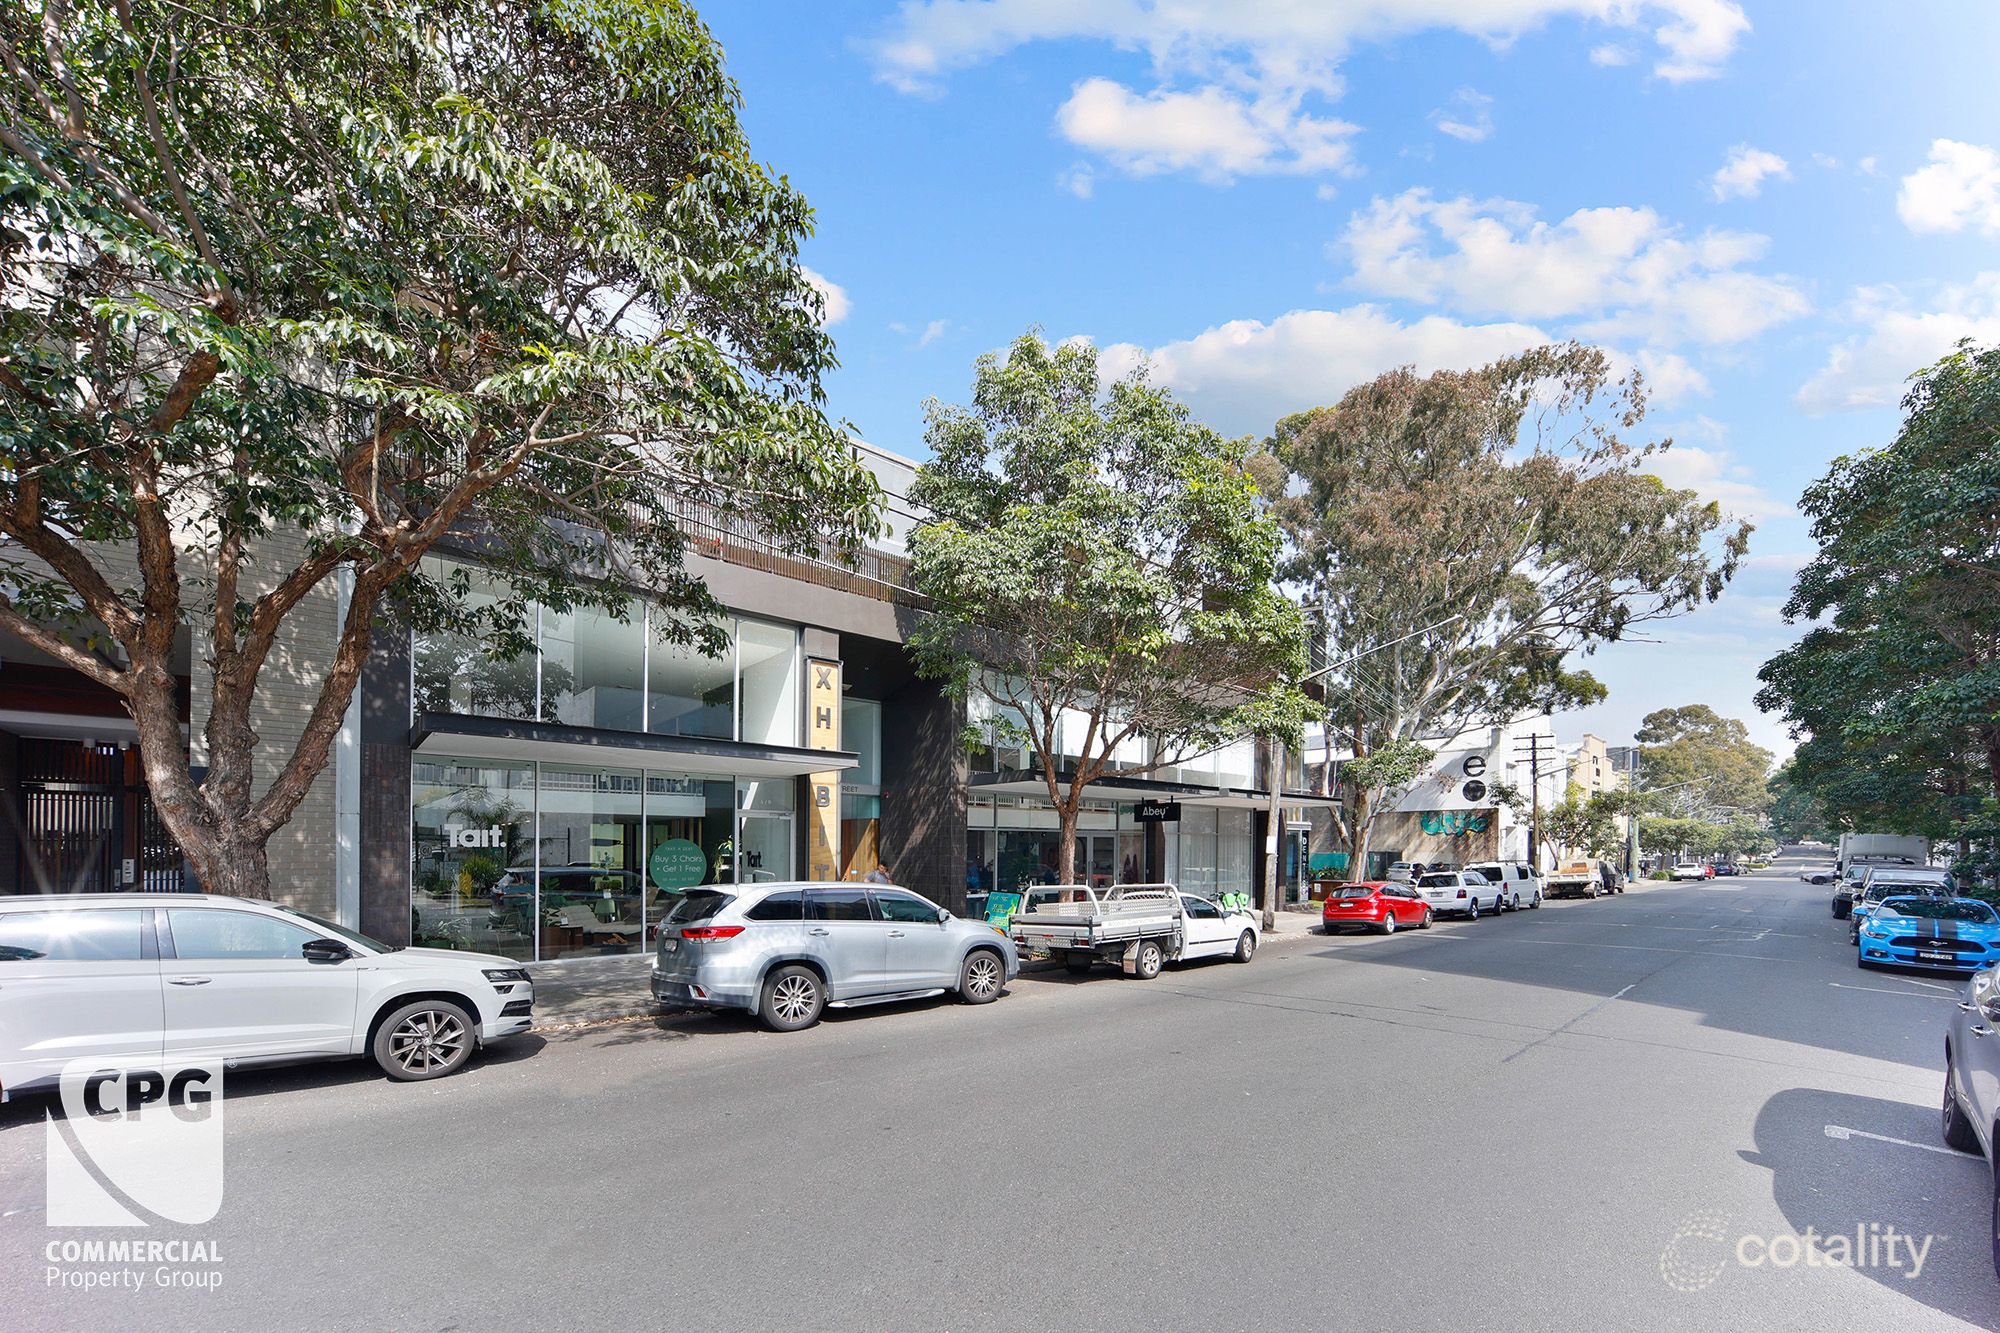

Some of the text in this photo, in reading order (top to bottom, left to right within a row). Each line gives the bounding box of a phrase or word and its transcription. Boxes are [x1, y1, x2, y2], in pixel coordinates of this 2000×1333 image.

[1463, 755, 1486, 777] e
[815, 667, 831, 881] XHBIT
[841, 785, 858, 793] REET
[444, 823, 507, 848] Tait.
[655, 855, 703, 863] Buy 3 Chairs
[662, 865, 677, 873] Get
[685, 865, 701, 873] Free
